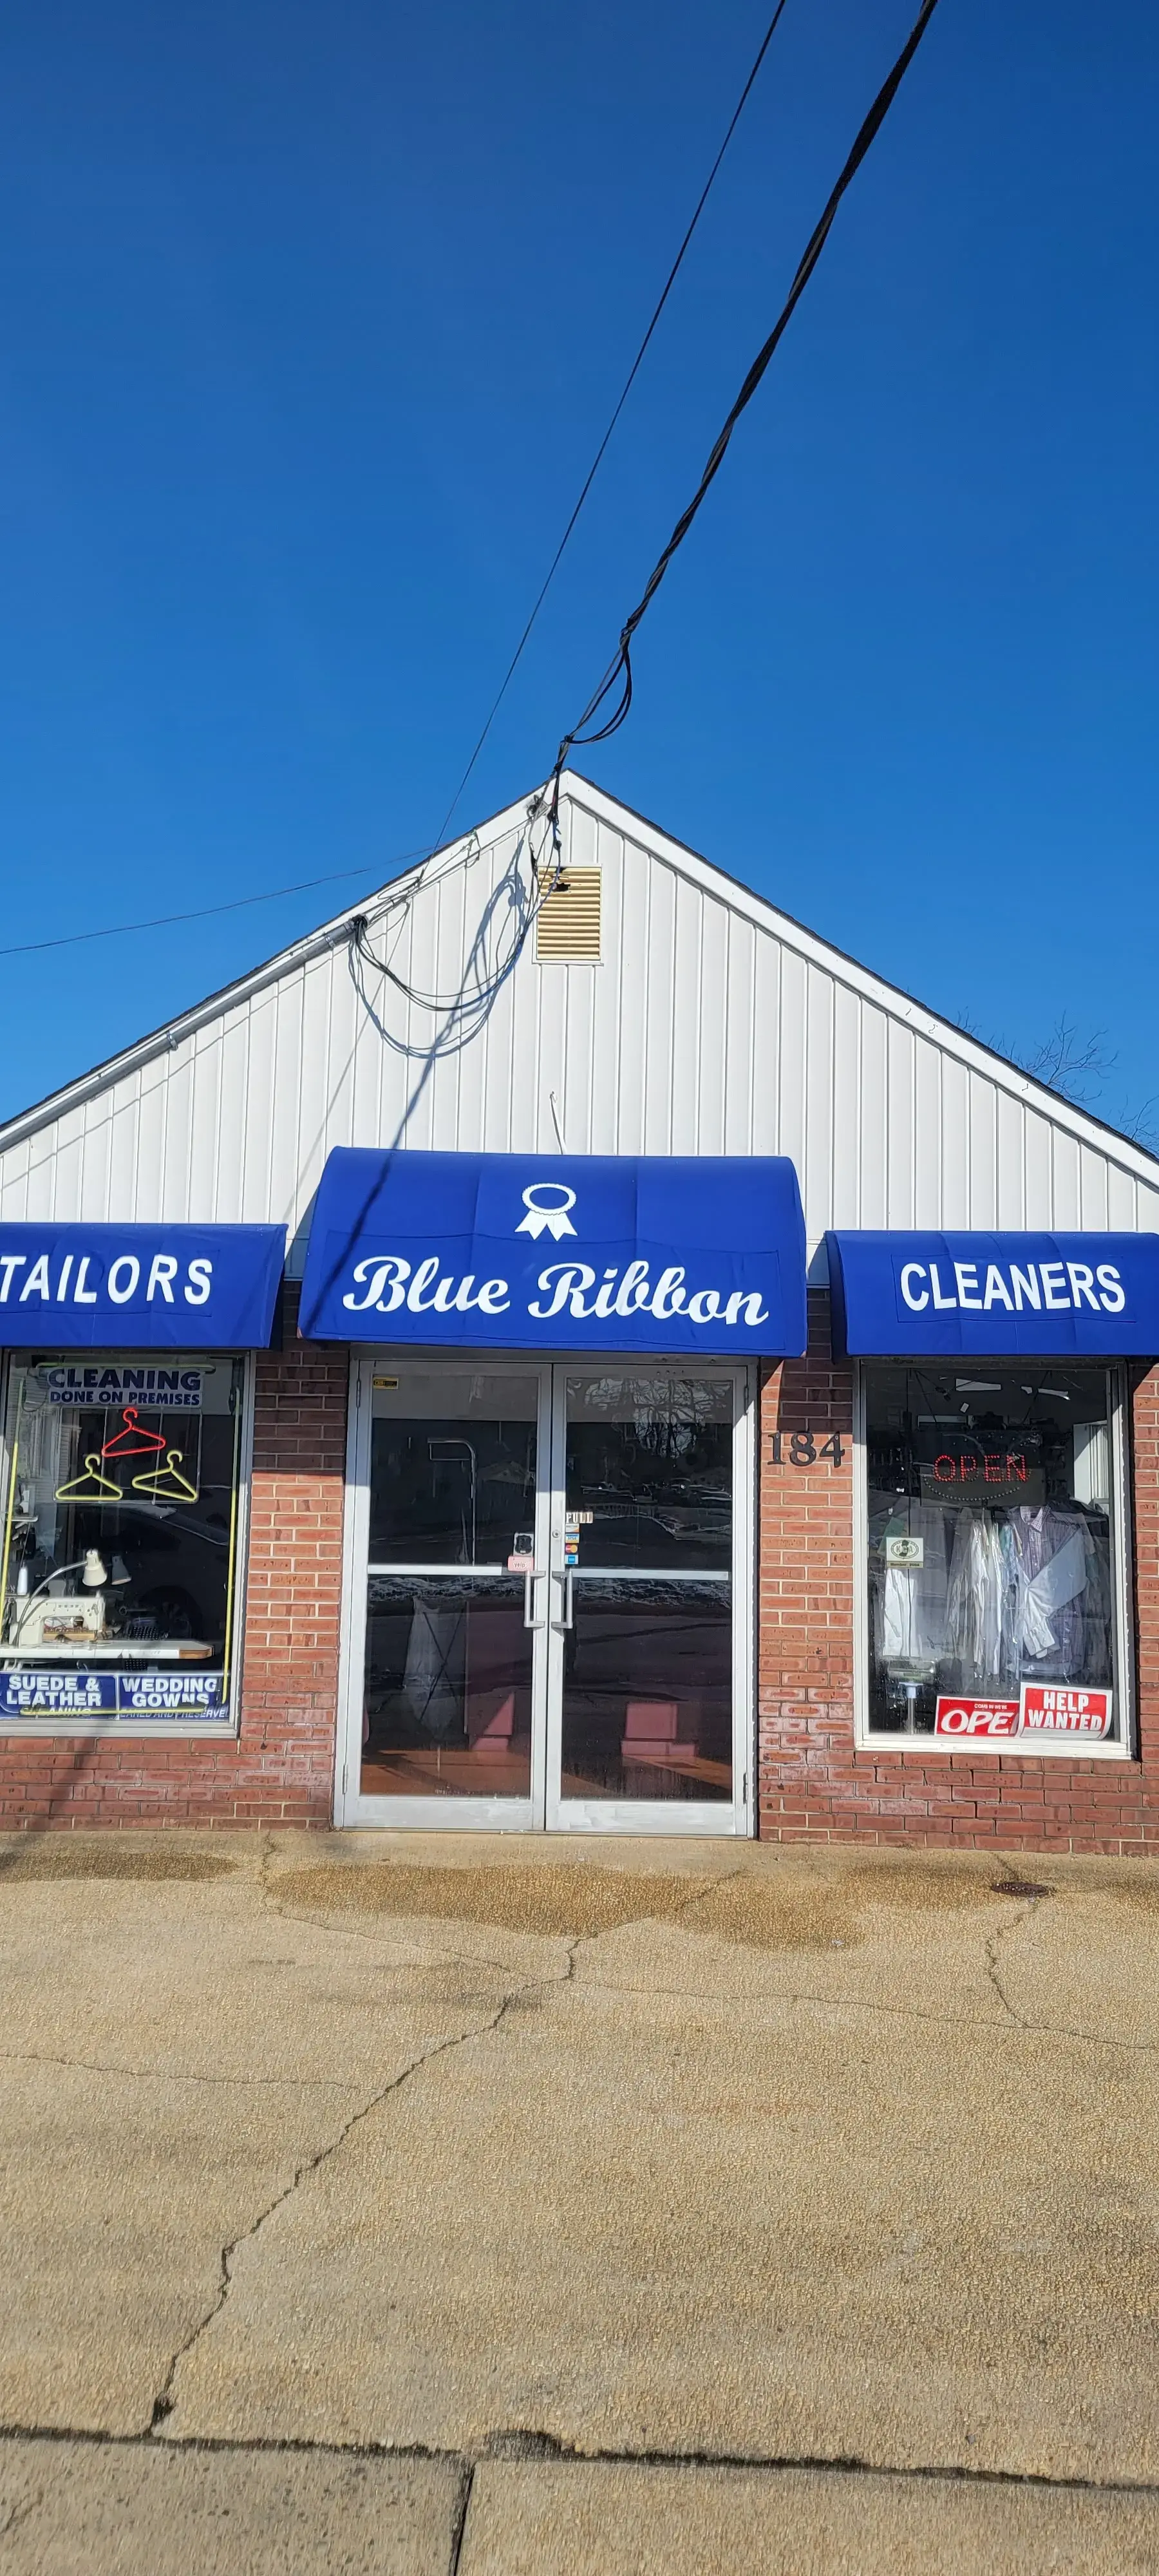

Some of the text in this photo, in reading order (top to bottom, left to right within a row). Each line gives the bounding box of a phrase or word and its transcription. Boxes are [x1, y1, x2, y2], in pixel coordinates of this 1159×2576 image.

[0, 1255, 212, 1305] TAILORS
[343, 1255, 769, 1327] Blue Ribbon
[901, 1262, 1126, 1313] CLEANERS
[48, 1368, 201, 1391] CLEANING
[50, 1391, 200, 1406] DONE ON PREMISES
[767, 1430, 845, 1468] 184
[932, 1454, 1030, 1482] OPEN
[566, 1511, 593, 1523] PULL
[9, 1676, 100, 1692] SUEDE &
[122, 1678, 217, 1692] WEDDING
[6, 1691, 102, 1707] LEATHER
[132, 1693, 209, 1707] GOWNS
[1043, 1691, 1089, 1713] HELP
[1028, 1709, 1103, 1731] WANTED
